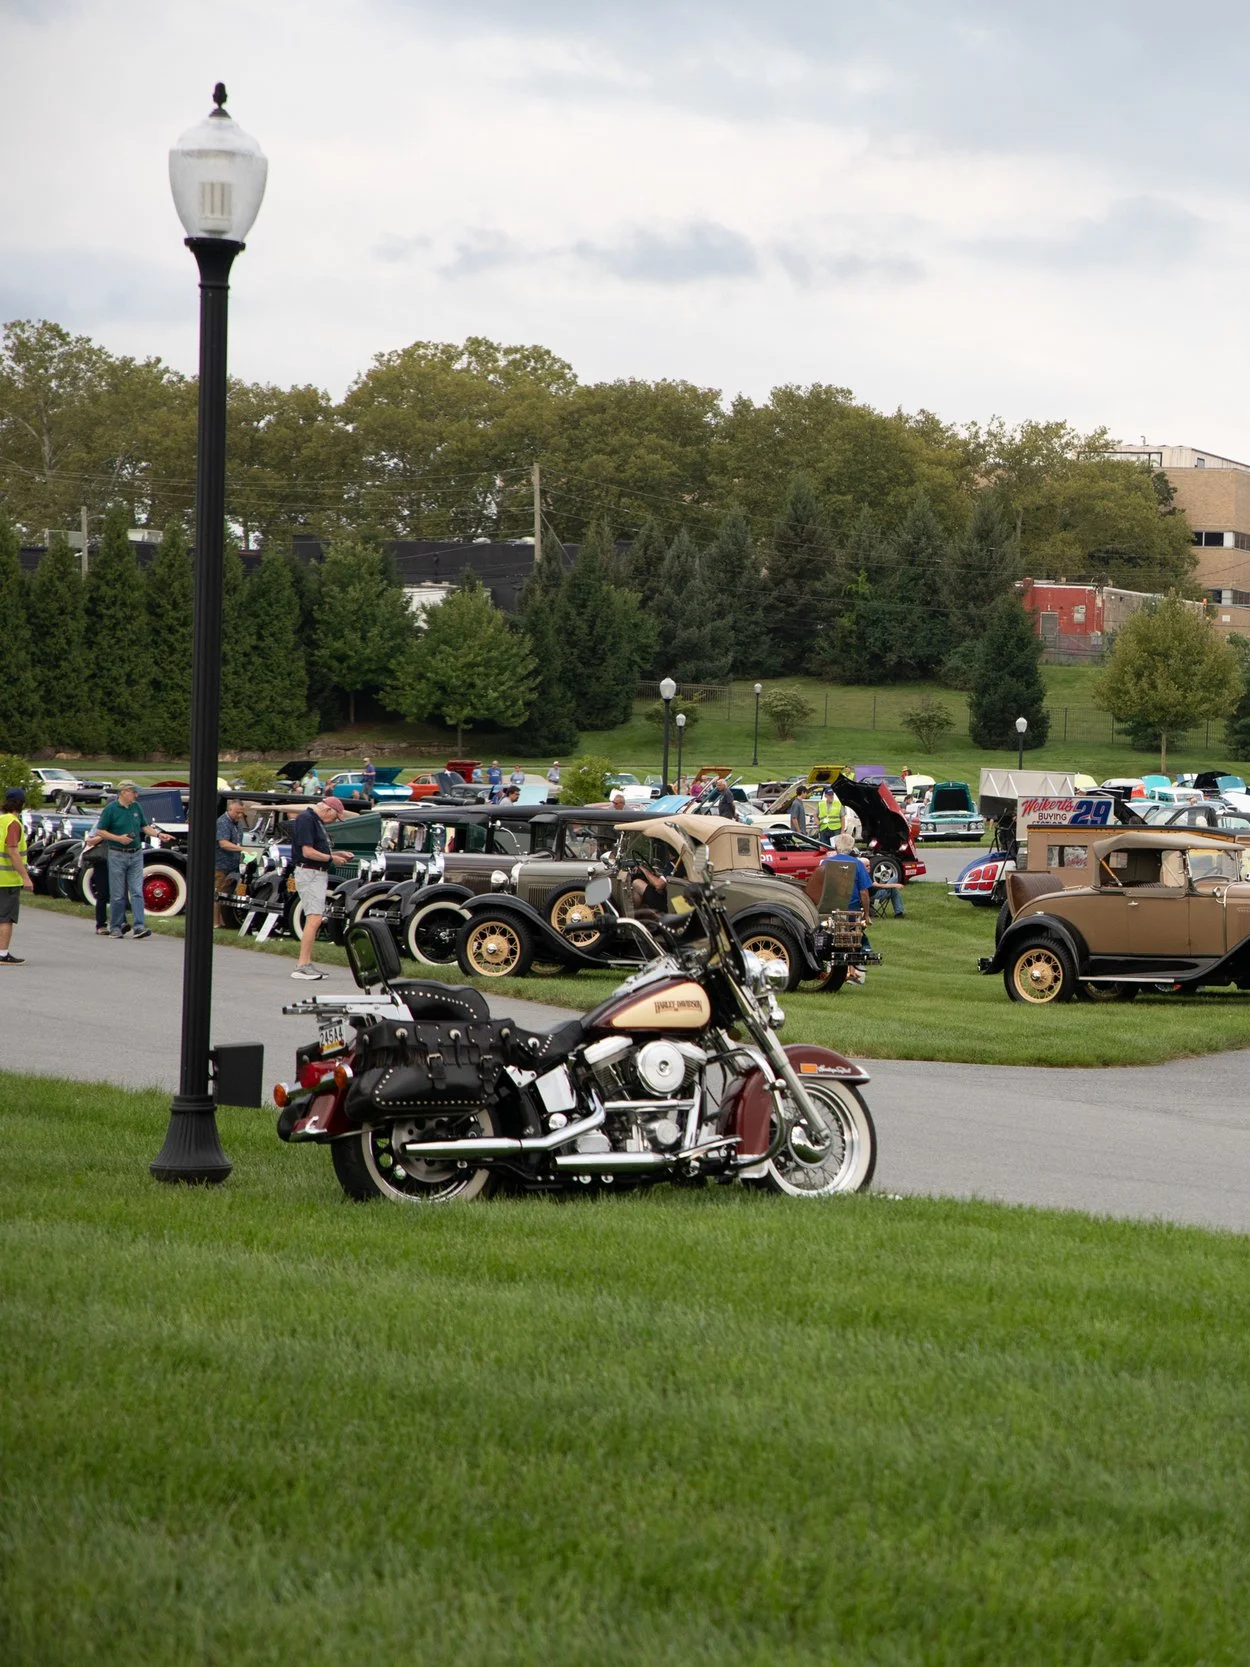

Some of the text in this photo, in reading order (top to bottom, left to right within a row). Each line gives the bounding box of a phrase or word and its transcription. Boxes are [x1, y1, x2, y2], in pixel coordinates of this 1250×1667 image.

[1021, 798, 1112, 825] Weikert's 29
[1038, 812, 1067, 821] BUYING
